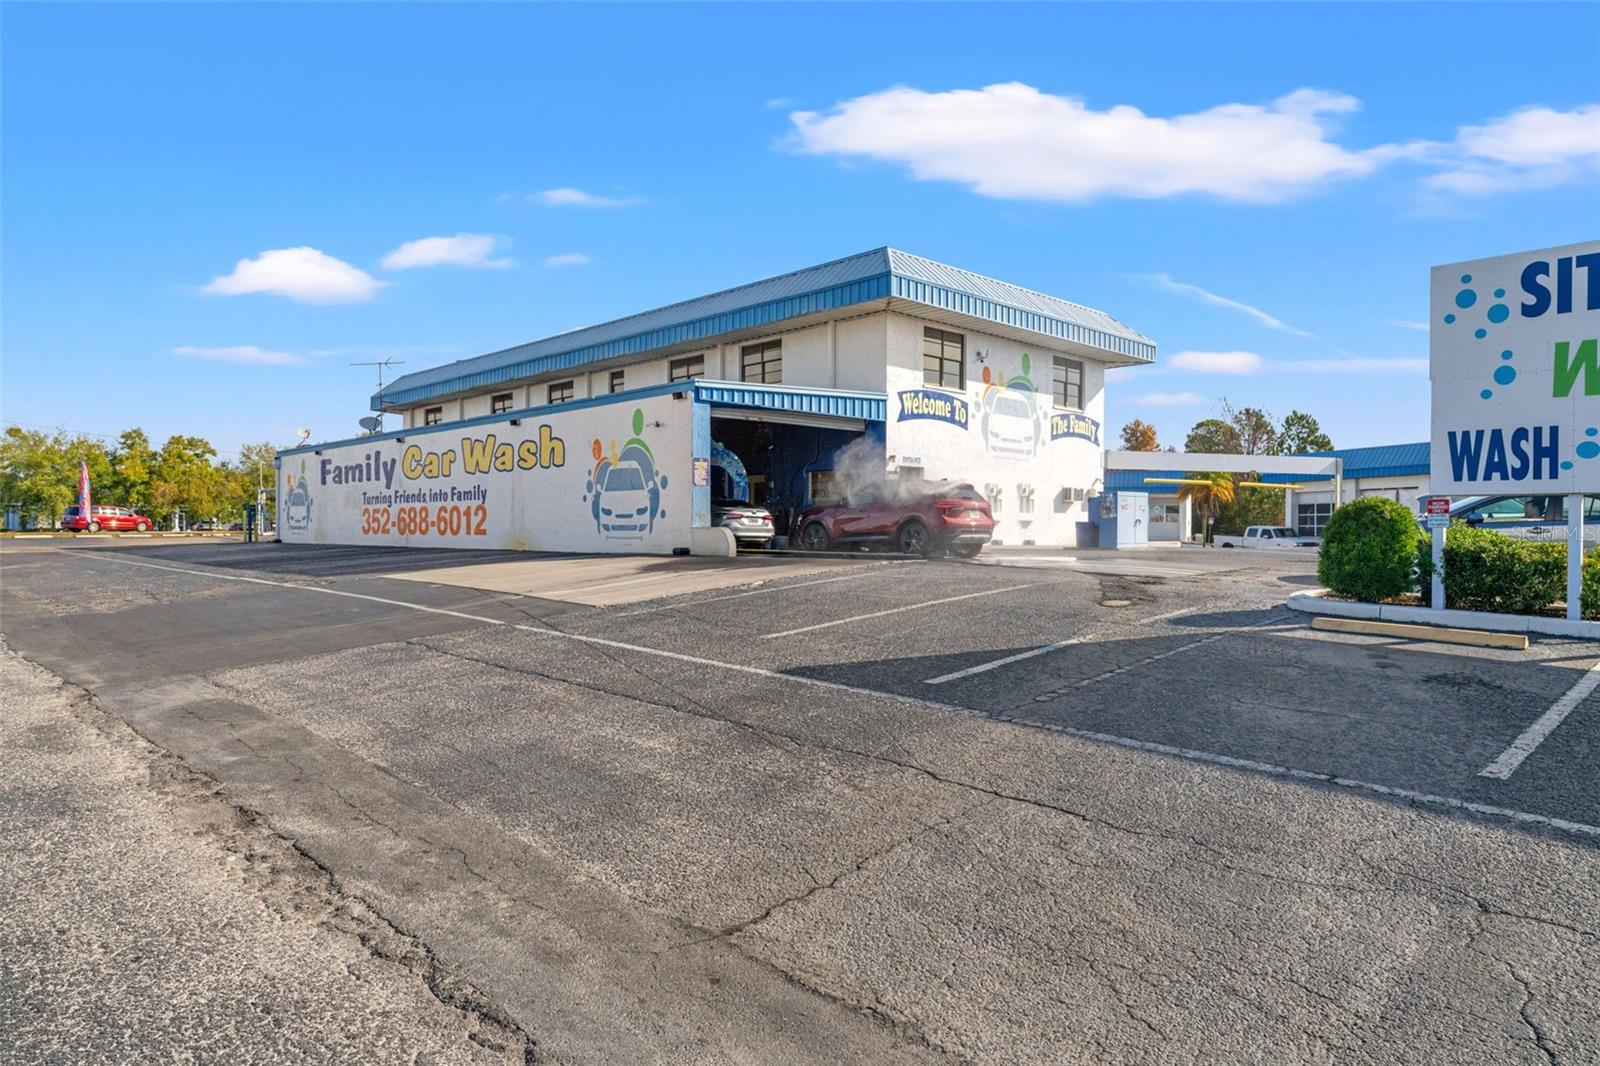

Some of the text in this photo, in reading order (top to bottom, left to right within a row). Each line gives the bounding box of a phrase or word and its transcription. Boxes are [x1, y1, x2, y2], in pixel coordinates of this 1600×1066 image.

[902, 392, 966, 423] Welcome To
[1052, 415, 1097, 442] The Family
[320, 424, 566, 490] Family Car Wash
[1447, 425, 1559, 482] WASH
[362, 492, 392, 508] Turning
[429, 488, 448, 502] into
[450, 484, 488, 504] Family
[361, 503, 488, 536] 352-688-6012
